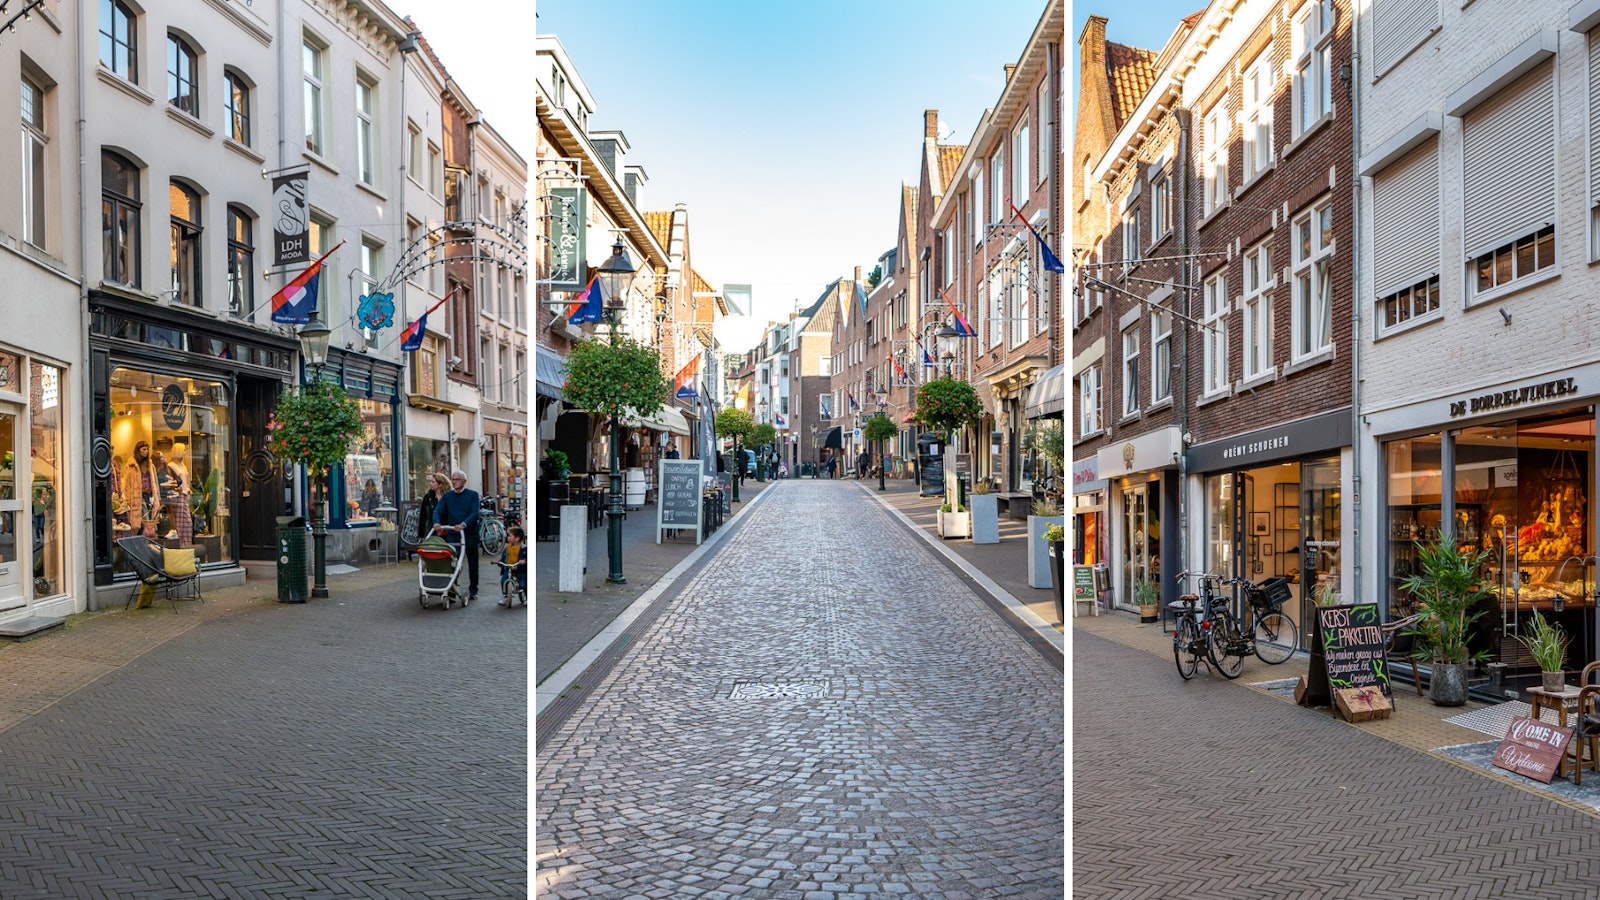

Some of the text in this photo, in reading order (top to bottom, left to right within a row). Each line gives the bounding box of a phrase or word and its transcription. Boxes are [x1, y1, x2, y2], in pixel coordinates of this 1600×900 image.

[281, 239, 303, 252] LDH
[281, 251, 303, 260] MODA
[1450, 377, 1578, 417] DE BORRELWINKEL
[1248, 435, 1289, 454] SCHOENEN
[1320, 608, 1351, 628] KERST
[1338, 626, 1382, 647] PAKKETTEN
[1549, 730, 1566, 748] IN
[1501, 745, 1545, 773] Welcome
